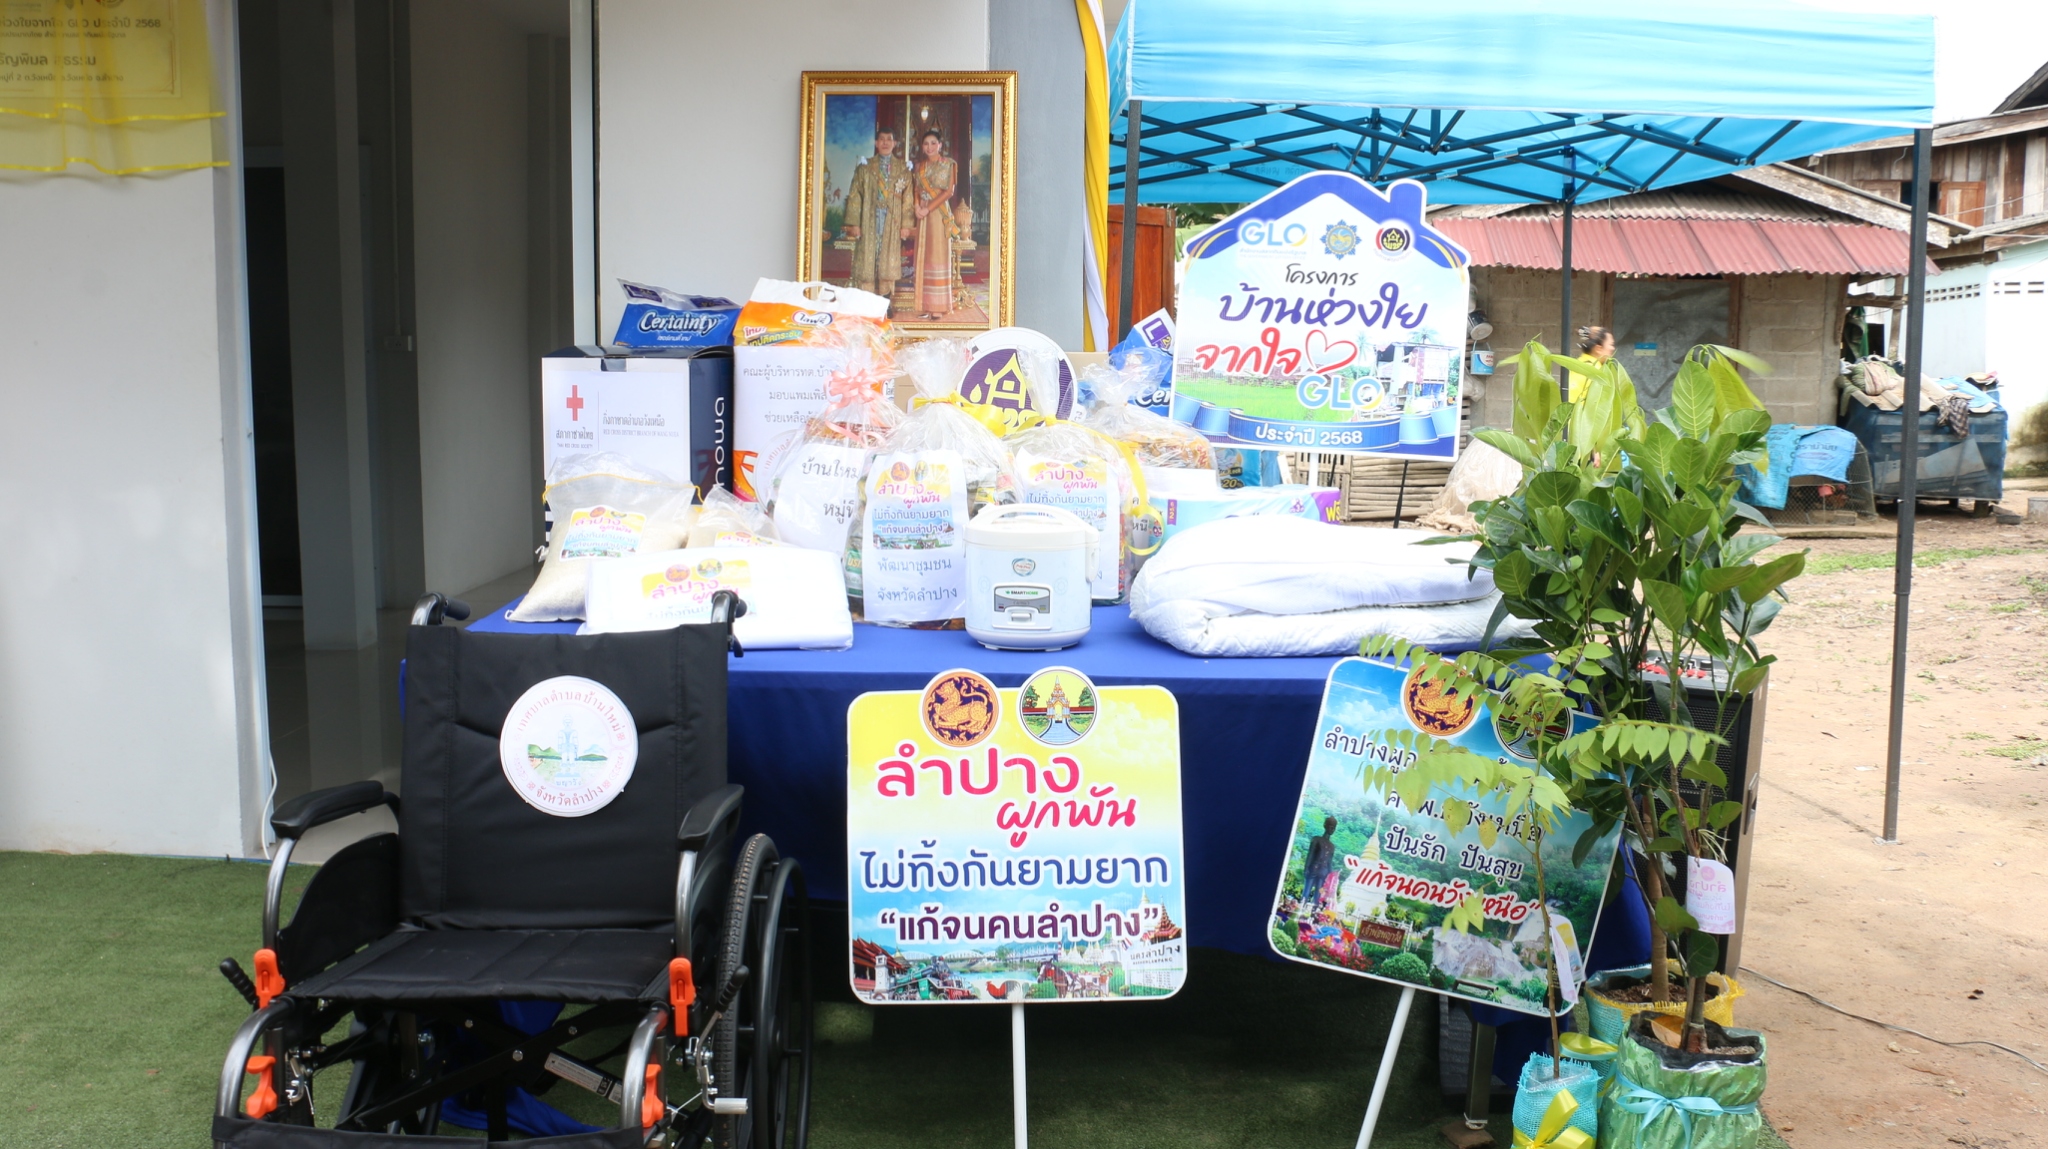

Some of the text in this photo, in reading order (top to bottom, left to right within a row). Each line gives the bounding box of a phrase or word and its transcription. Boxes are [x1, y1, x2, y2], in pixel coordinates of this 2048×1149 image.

[135, 18, 161, 28] 2568
[1241, 222, 1307, 247] GLO
[1285, 263, 1359, 286] โครงการ
[640, 311, 718, 336] Certainty
[1219, 282, 1428, 330] บ้านห่วงใย
[1195, 327, 1302, 375] จากใจ
[1299, 376, 1384, 411] GLO
[1255, 422, 1363, 445] ประจำปี 2568
[877, 557, 952, 576] พัฒนาชุมชน
[877, 586, 958, 602] จังหวัดลำปาง
[877, 743, 1079, 797] ลำปาง
[997, 786, 1137, 848] ผูกพัน
[860, 840, 1168, 889] ไม่ทิ้งกันยามยาก
[1386, 825, 1523, 885] ปันรัก ปันสุข
[881, 902, 1159, 941] “แก้จนคนลำปาง”
